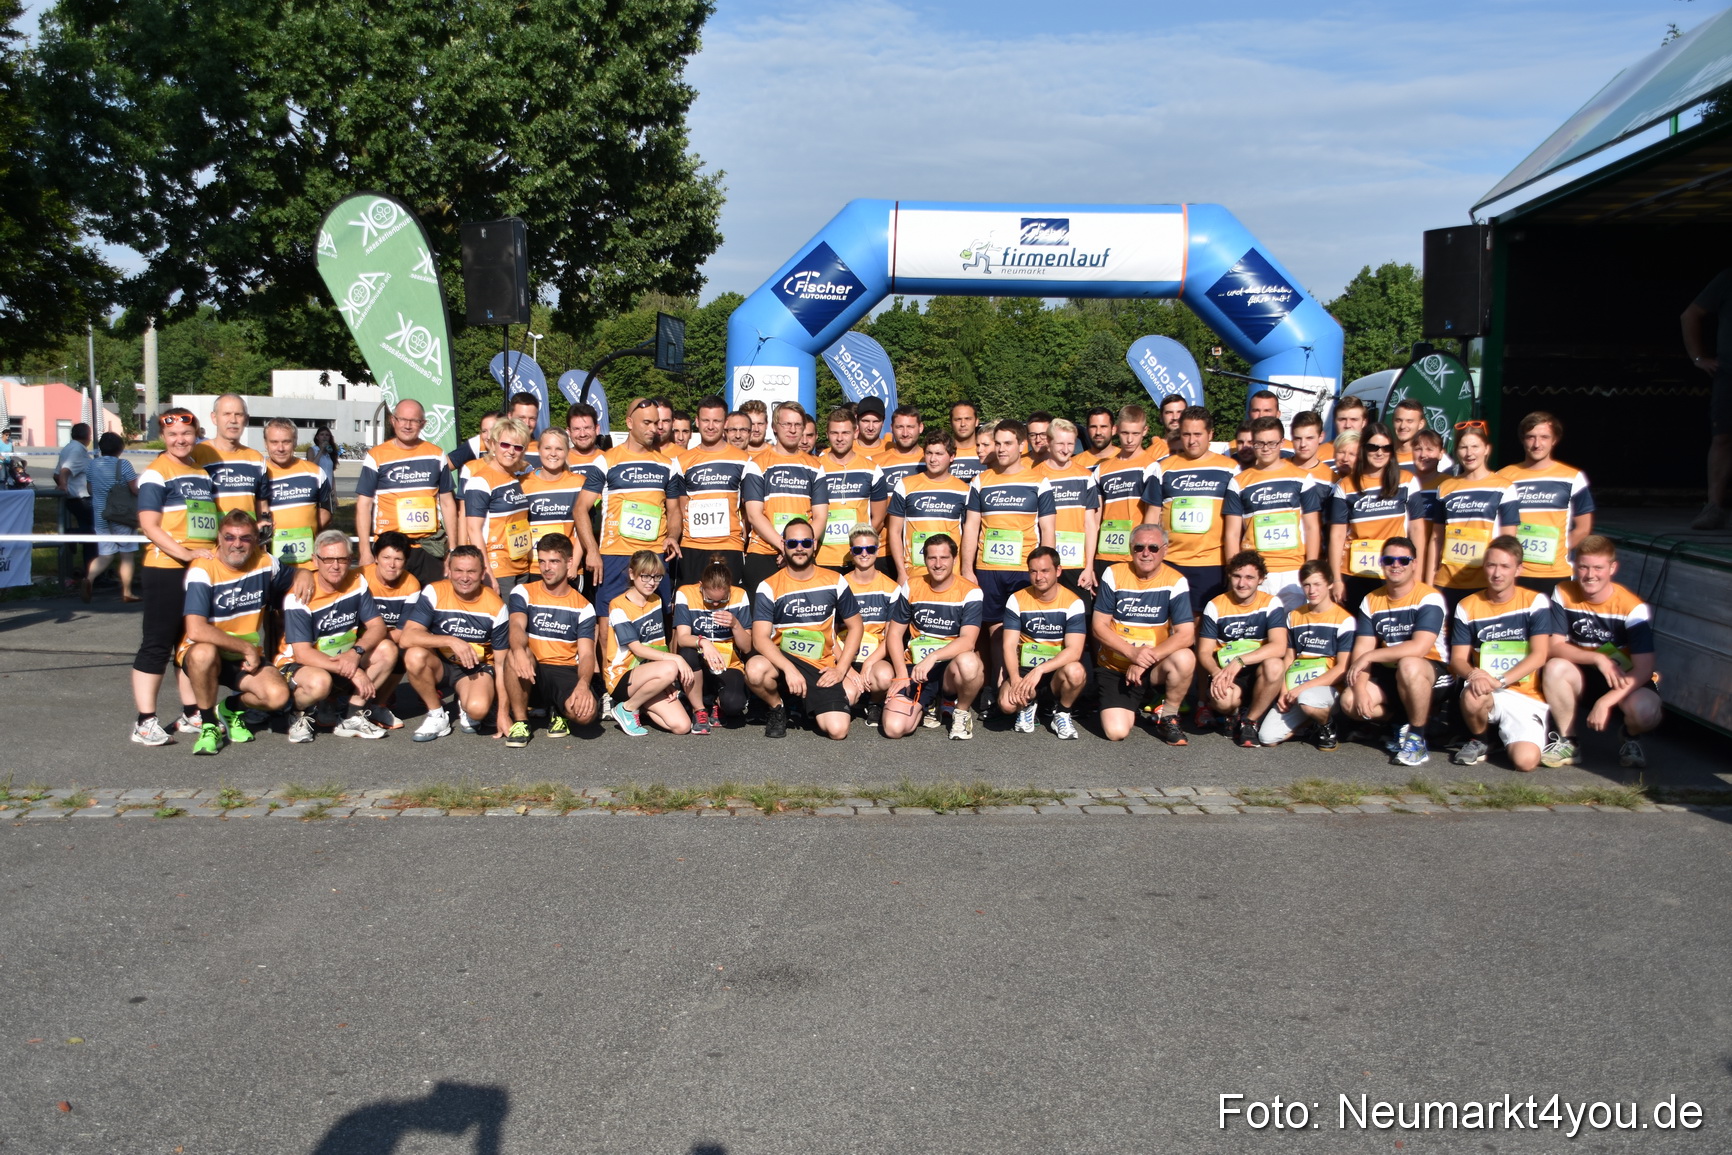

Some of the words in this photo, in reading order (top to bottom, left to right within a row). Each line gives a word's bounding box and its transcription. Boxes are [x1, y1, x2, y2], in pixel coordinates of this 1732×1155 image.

[1002, 247, 1111, 268] firmenlauf
[1001, 267, 1045, 275] neumarkt
[795, 281, 853, 294] Fischer
[1419, 354, 1454, 389] OK
[219, 474, 255, 483] Fischer
[395, 470, 432, 479] Fischer
[628, 471, 665, 480] Fischer
[698, 473, 732, 482] Fischer
[775, 477, 809, 486] Fischer
[827, 482, 863, 491] Fischer
[1108, 481, 1136, 491] Fischer
[1179, 479, 1219, 487] Fischer
[274, 486, 312, 497] Fischer
[1258, 491, 1293, 502] Fischer
[1517, 491, 1557, 500] Fischer
[279, 493, 311, 501] AUTOMOBILE
[991, 495, 1026, 503] Fischer
[536, 503, 570, 512] Fischer
[921, 501, 956, 510] Fischer
[1361, 499, 1398, 509] Fischer
[1365, 505, 1396, 513] AUTOMOBILE
[1452, 500, 1488, 510] Fischer
[406, 511, 430, 523] 466
[693, 511, 725, 526] 8917
[1179, 511, 1204, 523] 410
[191, 515, 216, 530] 1520
[627, 516, 652, 531] 428
[825, 523, 849, 535] 430
[1264, 528, 1289, 540] 454
[514, 535, 528, 549] 425
[1105, 533, 1125, 545] 426
[281, 541, 306, 555] 403
[990, 543, 1014, 556] 433
[1451, 542, 1476, 557] 401
[1521, 538, 1548, 553] 453
[792, 604, 828, 614] Fischer
[1122, 604, 1162, 613] Fischer
[536, 620, 571, 630] Fischer
[920, 615, 956, 626] Fischer
[788, 640, 815, 653] 397
